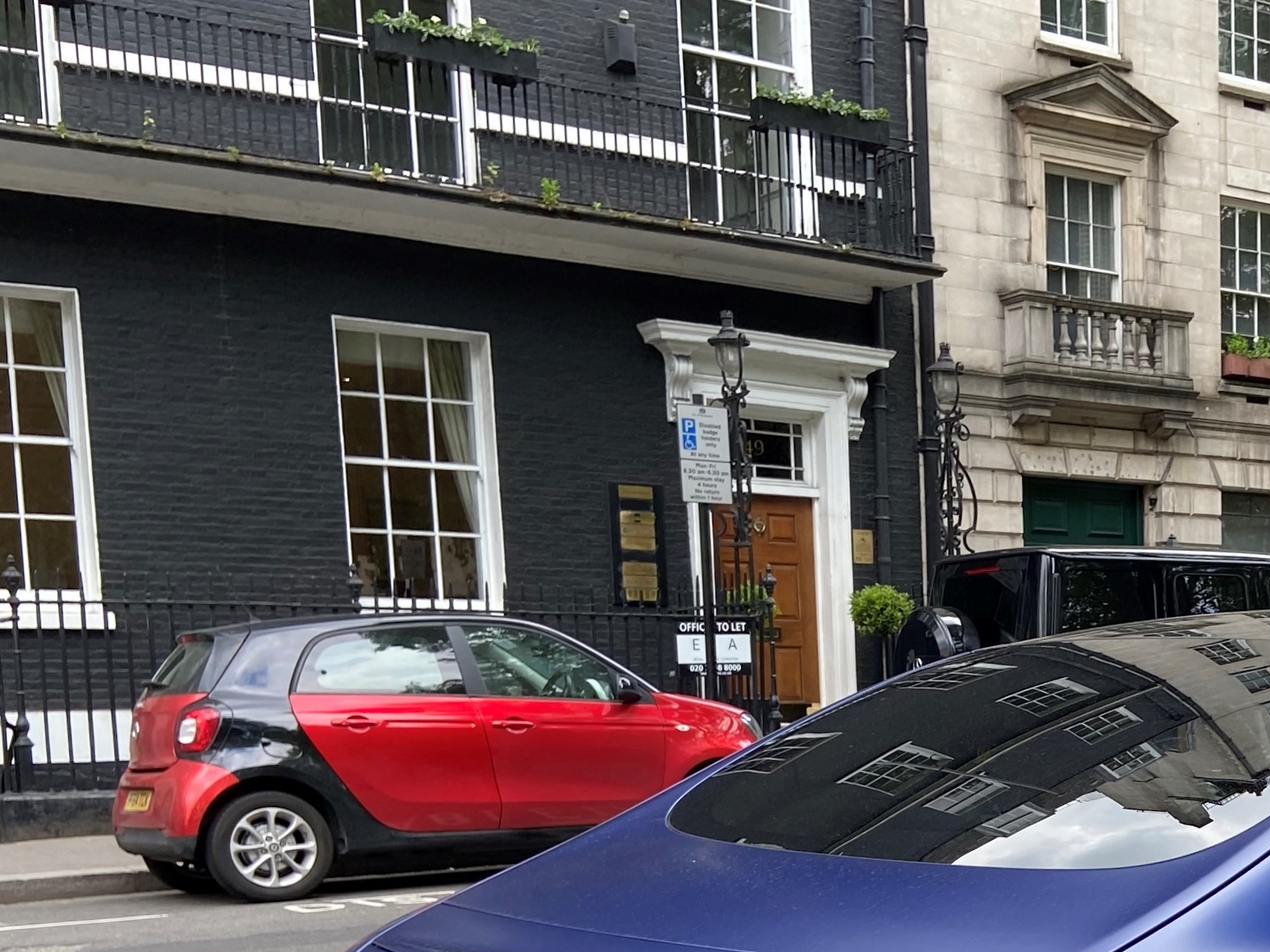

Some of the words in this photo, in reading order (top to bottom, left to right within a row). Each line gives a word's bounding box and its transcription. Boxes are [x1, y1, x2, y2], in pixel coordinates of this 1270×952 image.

[680, 622, 705, 632] OFFIC
[716, 622, 729, 632] TO
[731, 622, 746, 632] LET
[690, 664, 703, 672] 020
[724, 664, 741, 672] 8000
